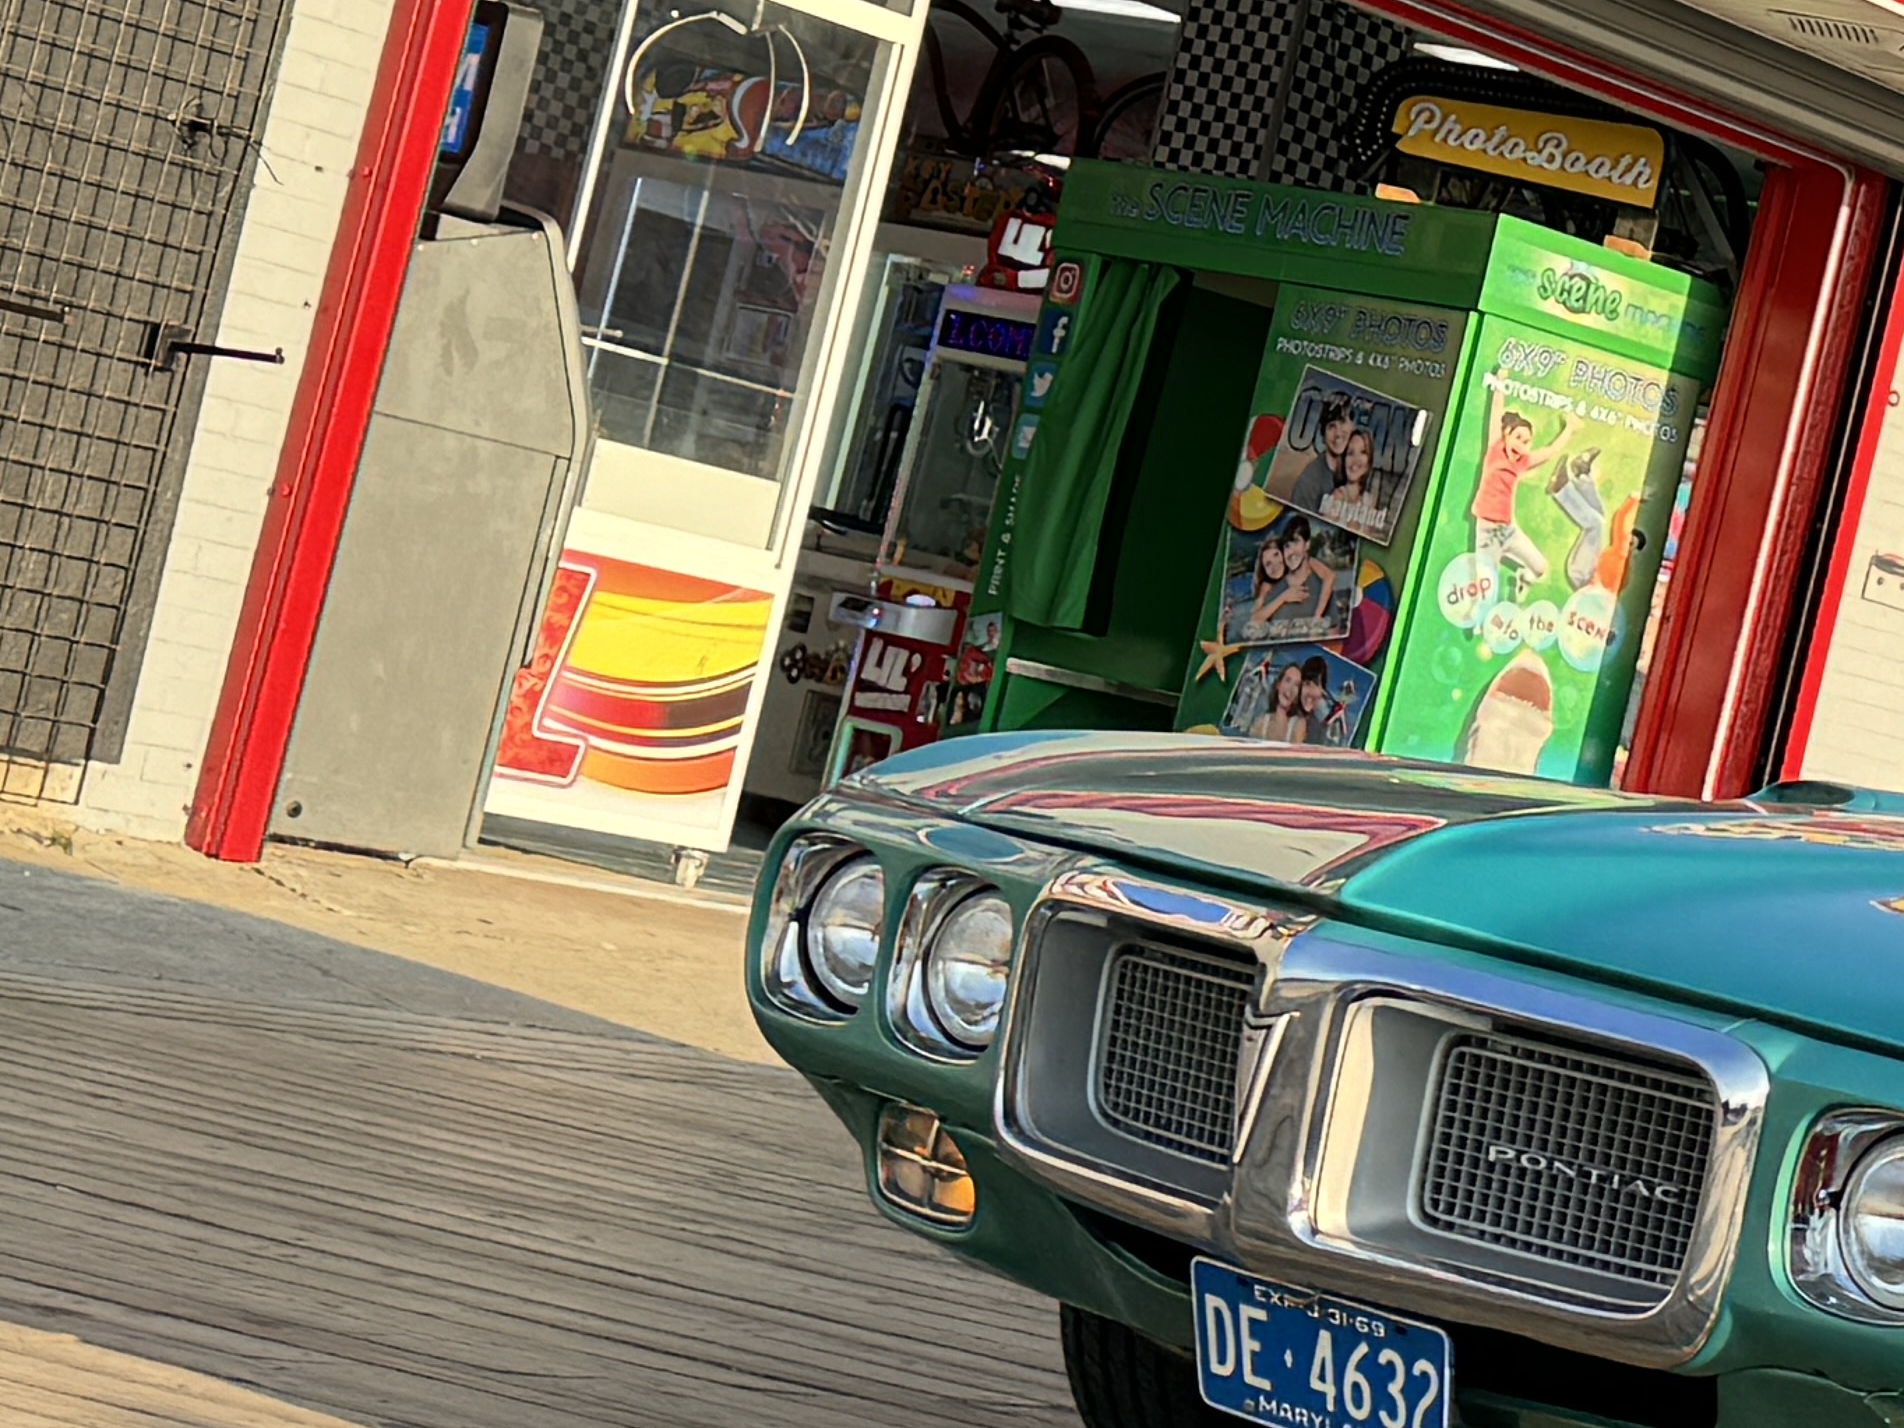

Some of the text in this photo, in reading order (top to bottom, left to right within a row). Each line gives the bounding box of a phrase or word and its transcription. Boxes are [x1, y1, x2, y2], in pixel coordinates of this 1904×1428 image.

[1145, 182, 1254, 233] SCENE
[1255, 194, 1412, 256] MACHINE
[1537, 268, 1622, 321] scene
[1569, 357, 1679, 417] PHOTOS
[1446, 577, 1491, 606] drop
[1488, 1145, 1681, 1204] PONTIAC
